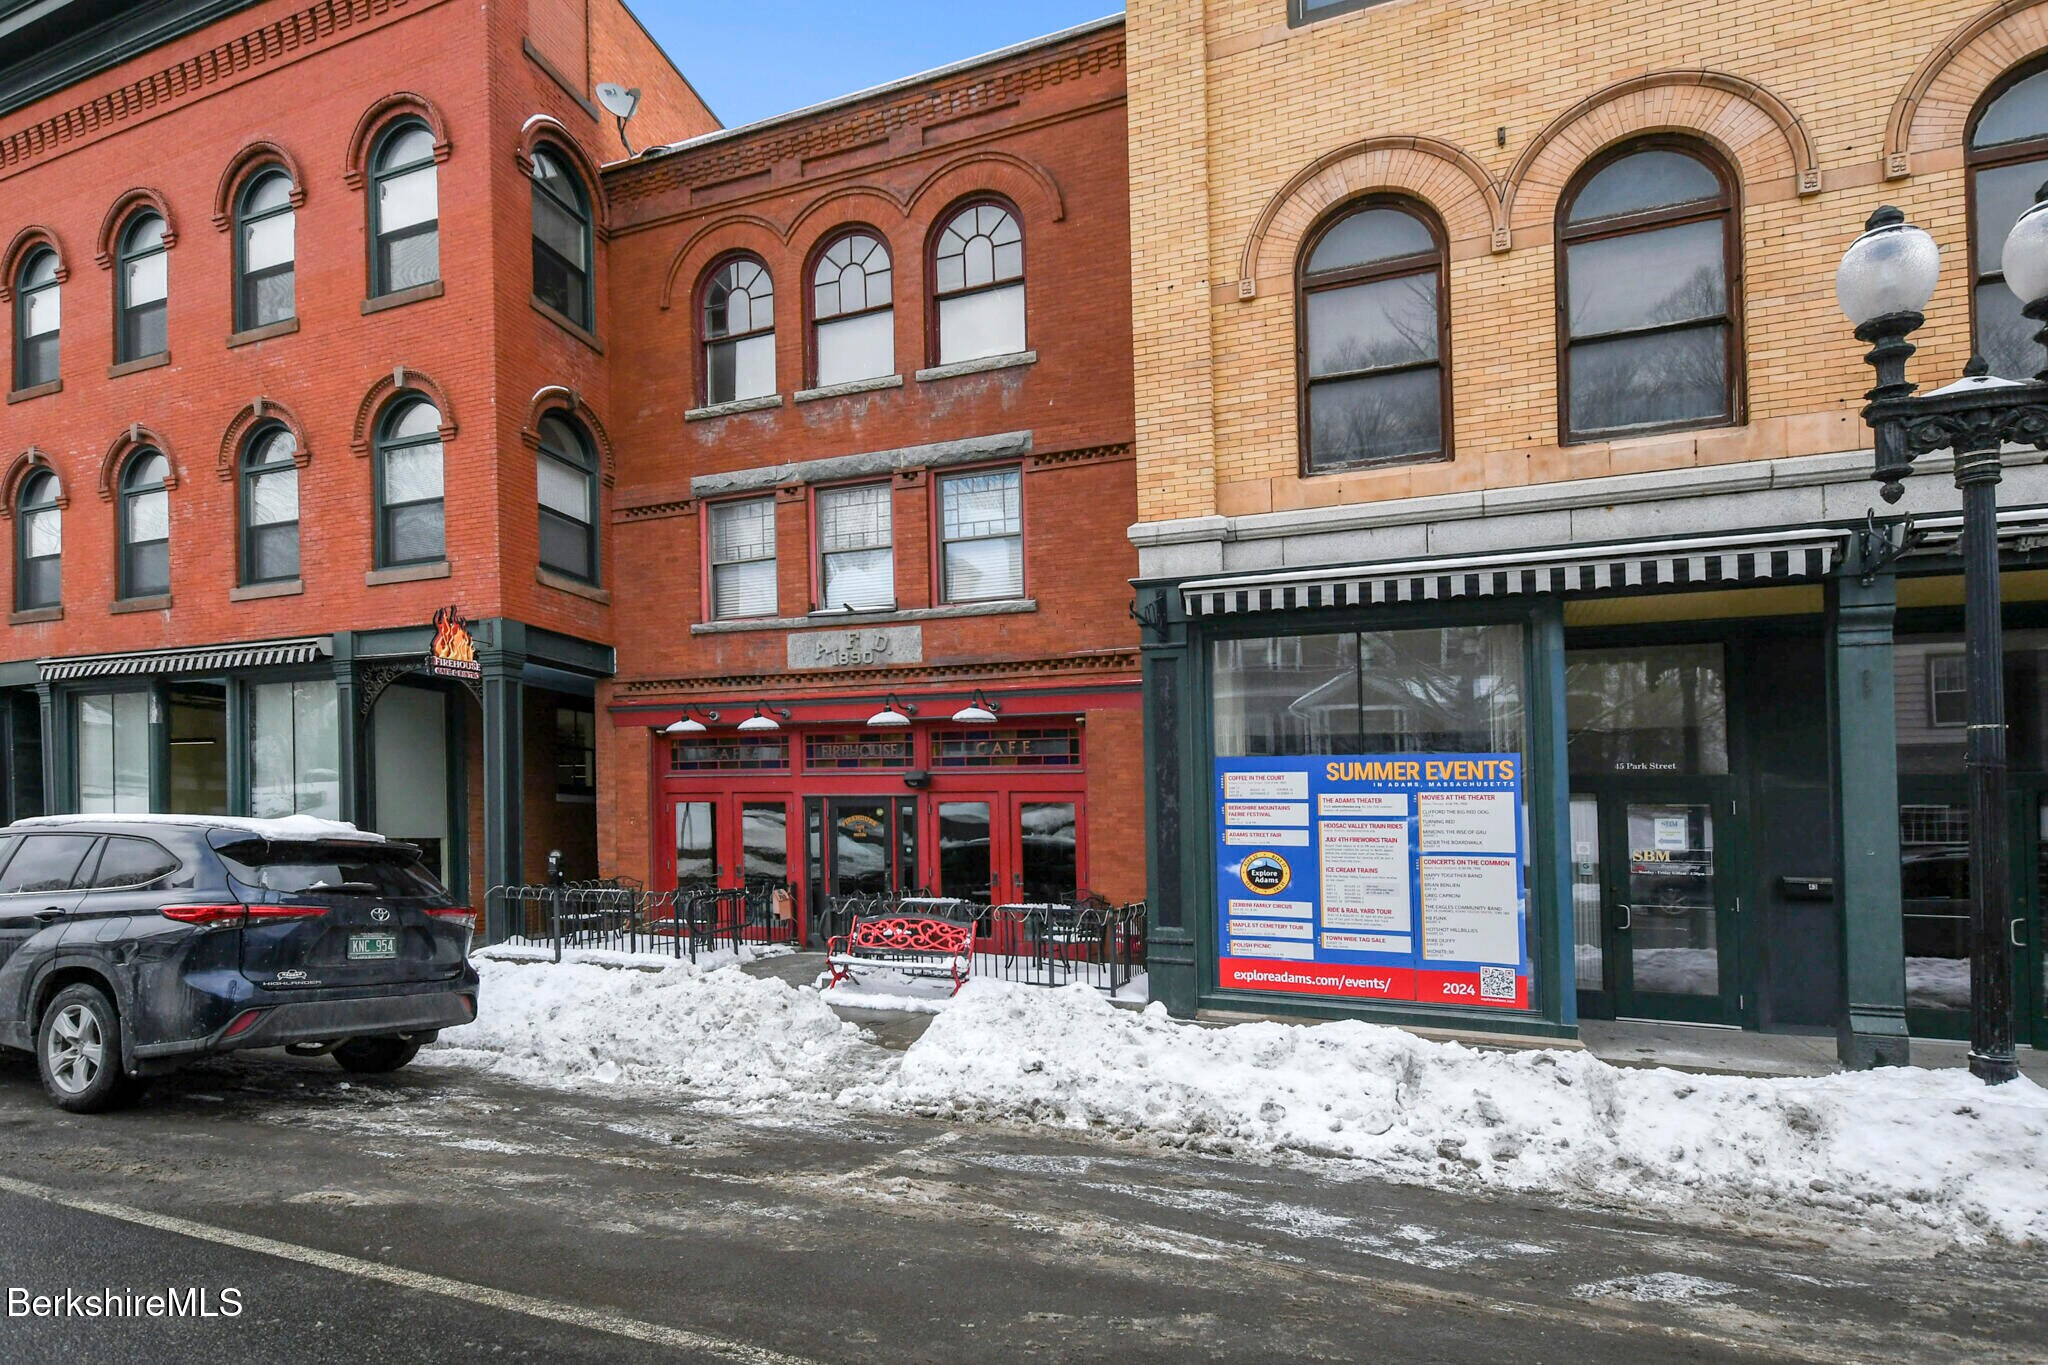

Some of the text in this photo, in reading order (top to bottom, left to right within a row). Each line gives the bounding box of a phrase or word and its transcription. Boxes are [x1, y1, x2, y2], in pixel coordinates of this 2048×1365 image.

[435, 658, 481, 671] FIREHOUSE
[831, 652, 874, 666] 1890
[976, 740, 1031, 755] CAFE
[1326, 760, 1514, 781] SUMMER EVENTS
[1626, 762, 1648, 770] Park
[1649, 762, 1677, 770] Street
[1632, 849, 1671, 863] SBM
[1251, 869, 1278, 877] Explore
[1254, 876, 1279, 884] Adams
[352, 939, 394, 953] KNC 954
[1234, 970, 1392, 993] exploreadams.com/events/
[1442, 982, 1476, 996] 2024
